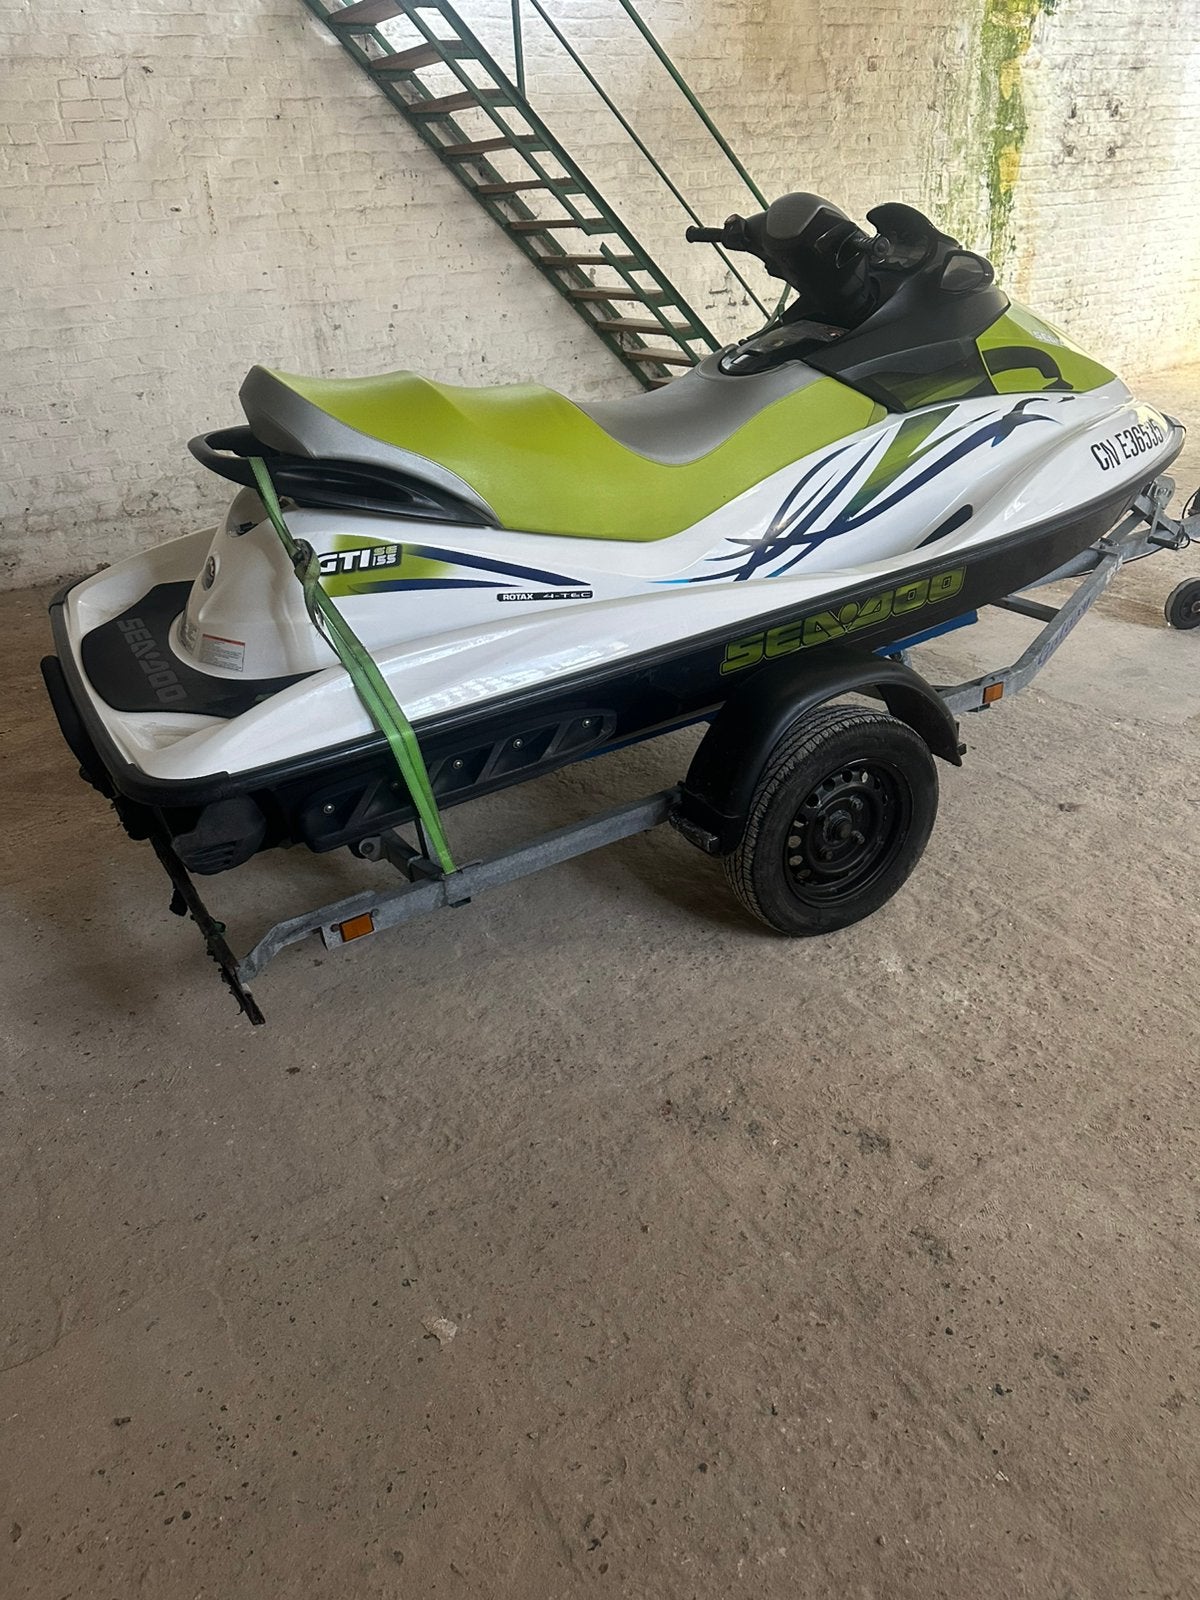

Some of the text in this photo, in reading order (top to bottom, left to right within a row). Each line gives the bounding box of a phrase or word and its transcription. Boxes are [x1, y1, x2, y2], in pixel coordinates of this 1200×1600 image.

[1090, 439, 1121, 471] CN
[318, 549, 371, 573] GTI
[372, 553, 397, 567] 155
[502, 591, 591, 601] ROTAX 4-TEC
